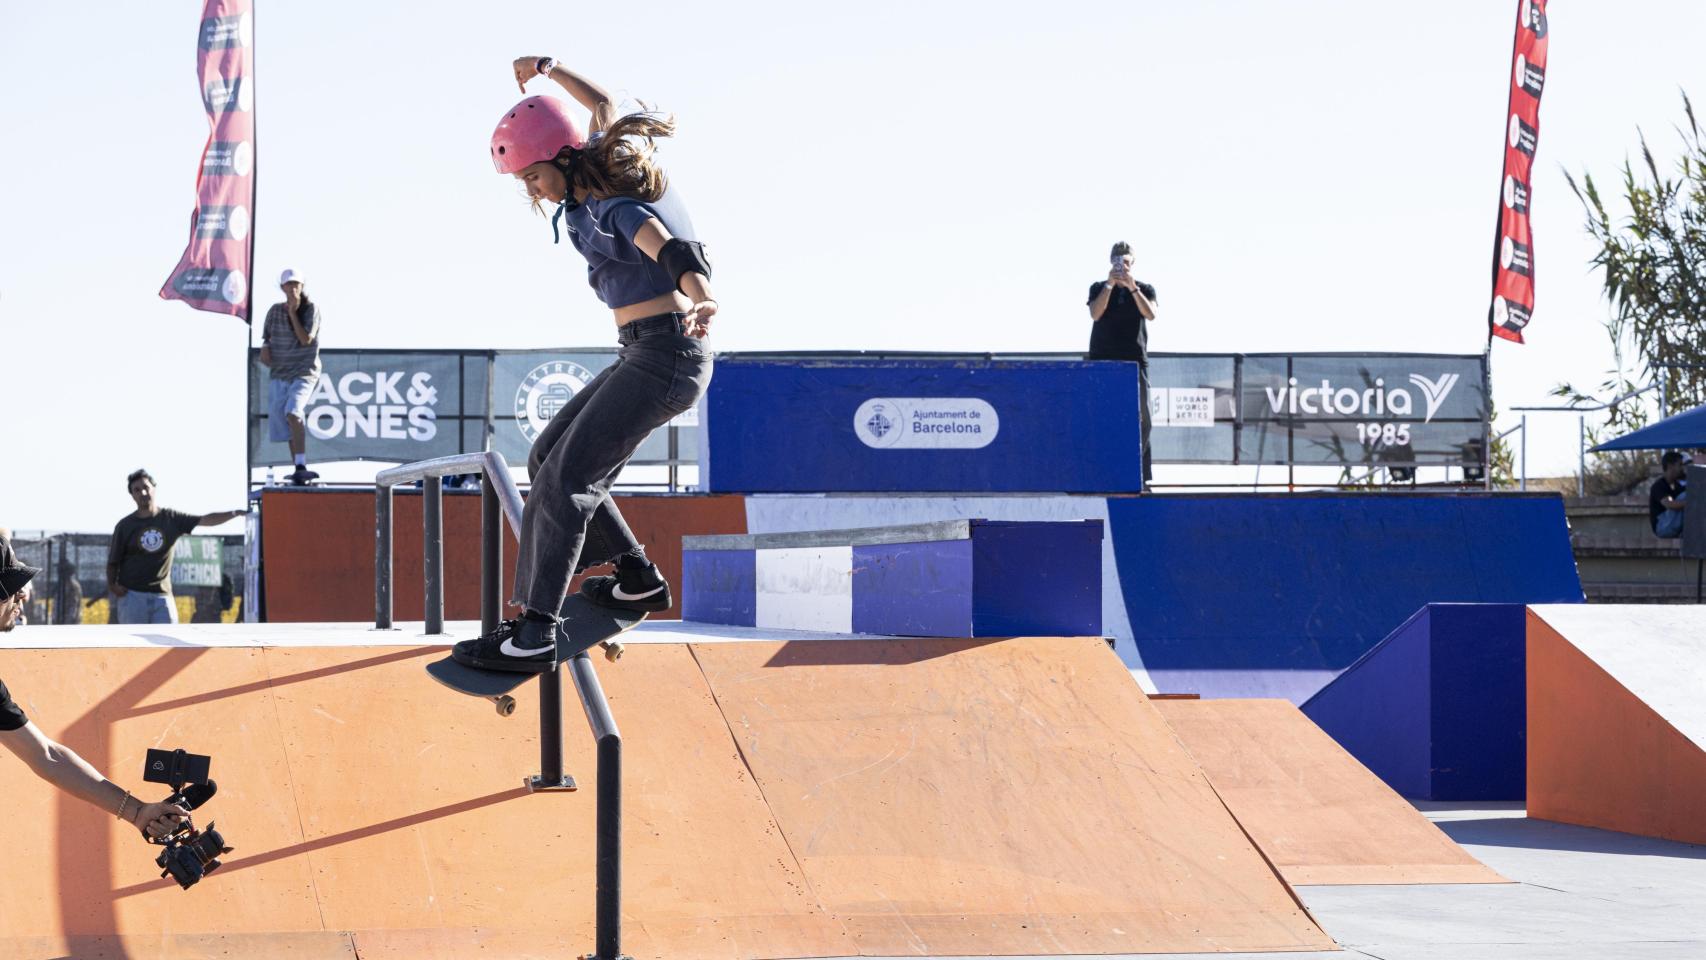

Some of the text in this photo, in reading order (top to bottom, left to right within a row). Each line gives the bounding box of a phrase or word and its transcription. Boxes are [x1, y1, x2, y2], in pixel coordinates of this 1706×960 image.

[305, 371, 438, 406] ACK&
[1175, 395, 1208, 403] URBAN
[1265, 377, 1412, 415] victoria
[912, 410, 981, 421] Ajuntament de
[1175, 403, 1208, 411] WORLD
[304, 405, 437, 442] ONES
[912, 421, 981, 434] Barcelona
[1356, 423, 1411, 446] 1985
[202, 537, 219, 560] DE
[172, 562, 222, 587] RGENCIA
